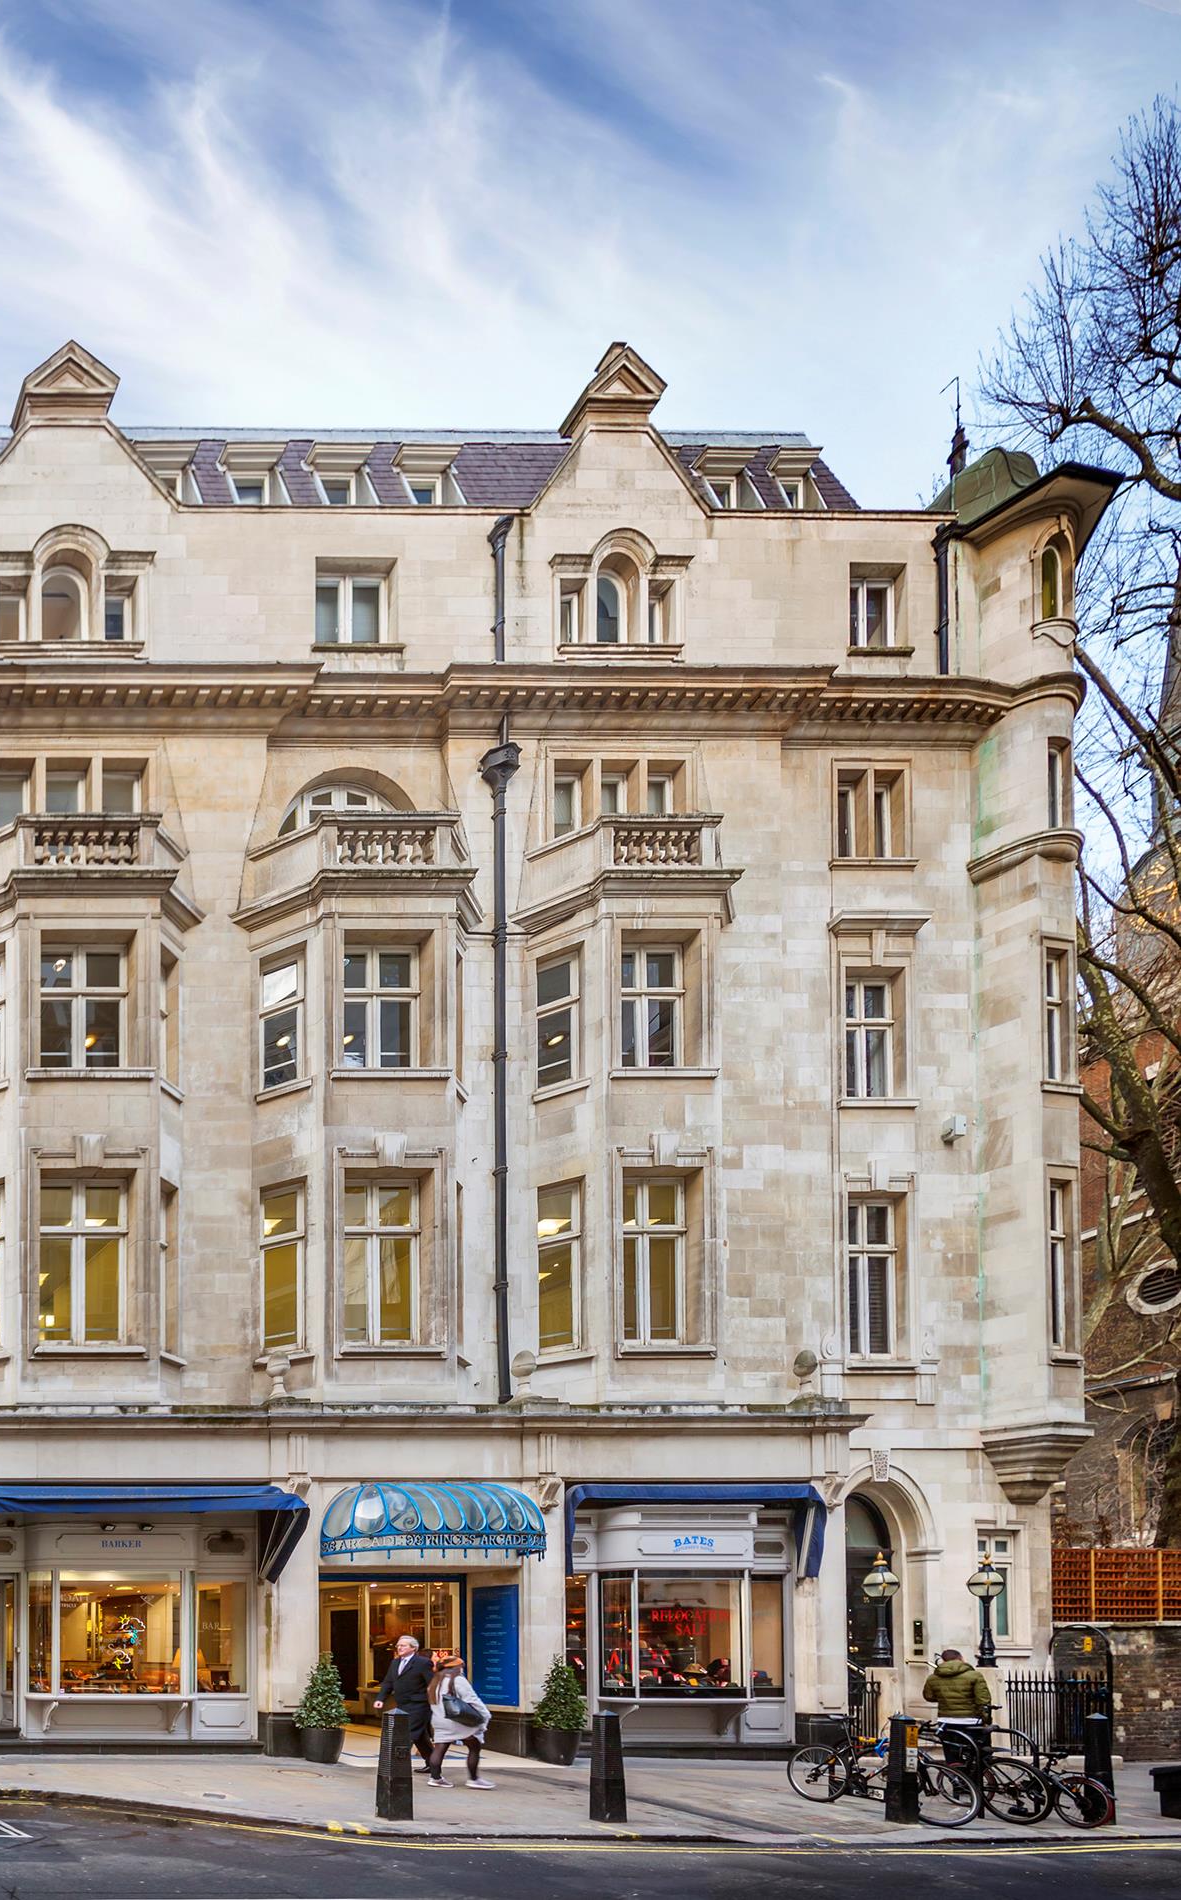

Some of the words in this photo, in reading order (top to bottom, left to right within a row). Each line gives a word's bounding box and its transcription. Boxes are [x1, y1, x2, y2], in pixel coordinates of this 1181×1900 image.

[101, 1540, 142, 1548] BARKER
[425, 1534, 475, 1546] PRINCES
[481, 1534, 528, 1546] ARCADE
[673, 1535, 715, 1548] BATES
[651, 1609, 732, 1623] RELOCATION
[675, 1622, 706, 1636] SALE
